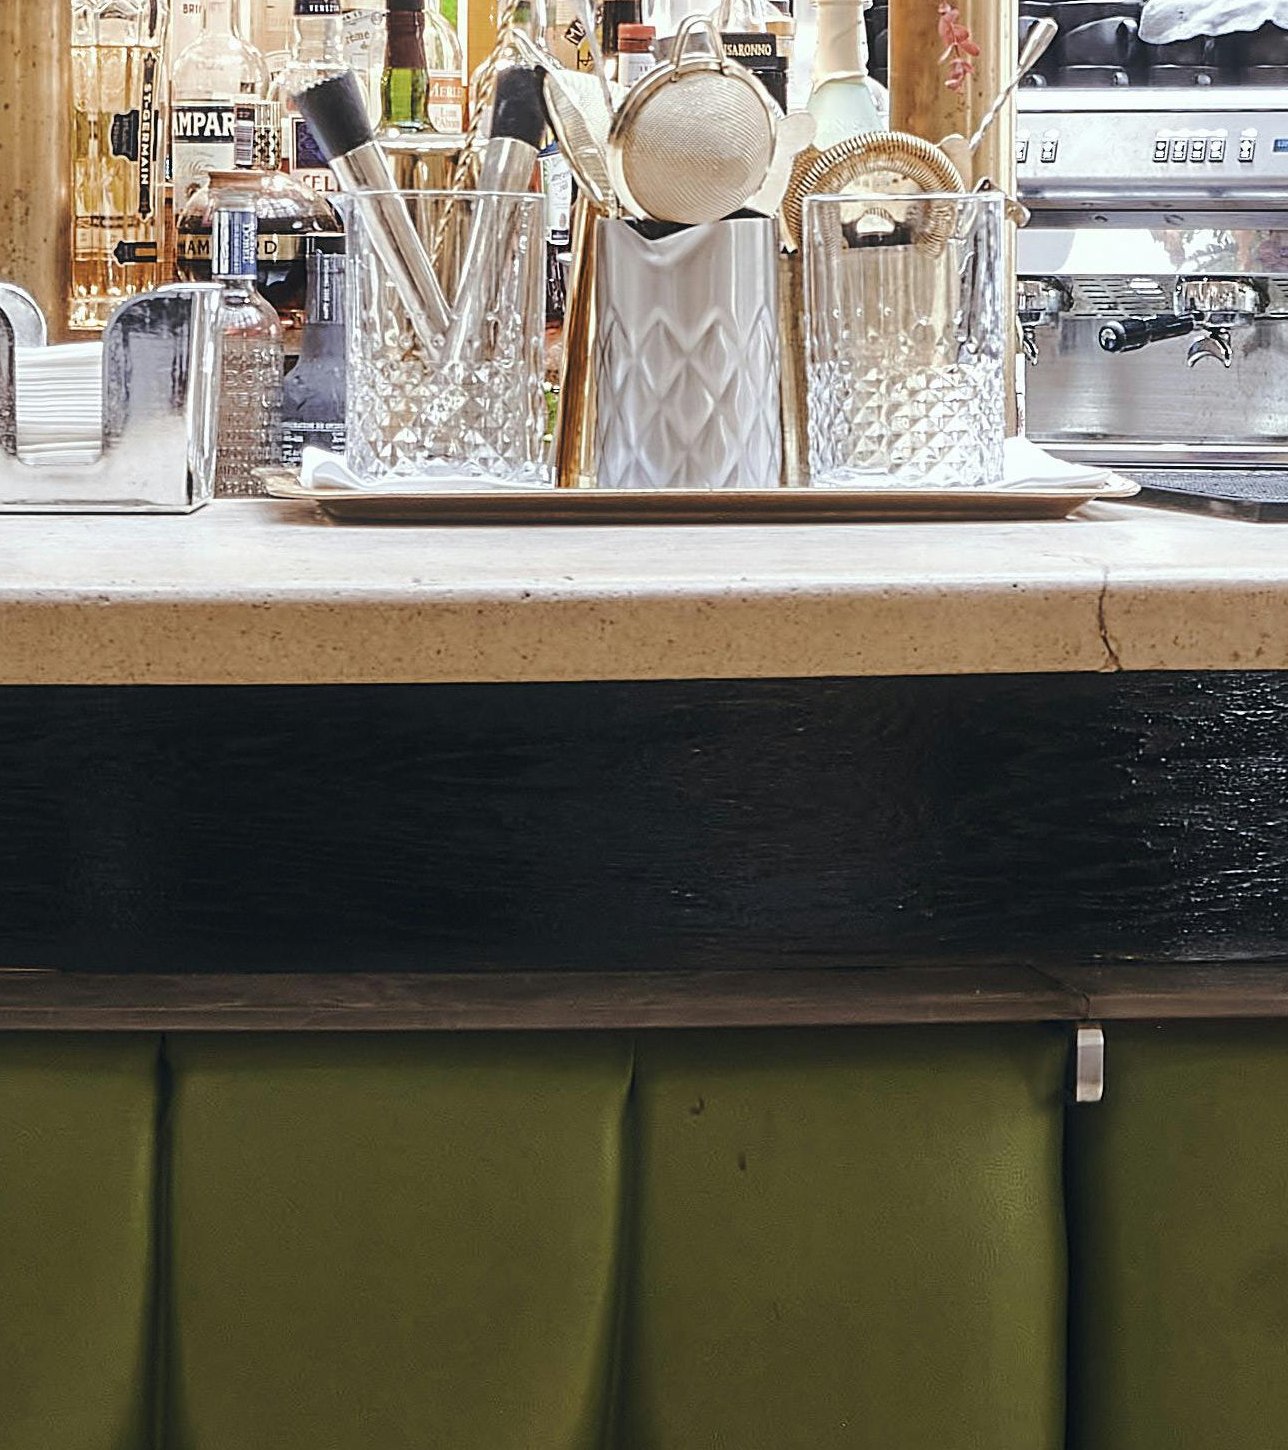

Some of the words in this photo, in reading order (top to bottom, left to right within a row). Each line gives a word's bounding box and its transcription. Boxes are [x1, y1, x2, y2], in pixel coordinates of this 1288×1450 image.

[722, 42, 773, 57] ISARONNO
[140, 82, 153, 186] ST-GERMAIN
[171, 110, 236, 138] AMPAR
